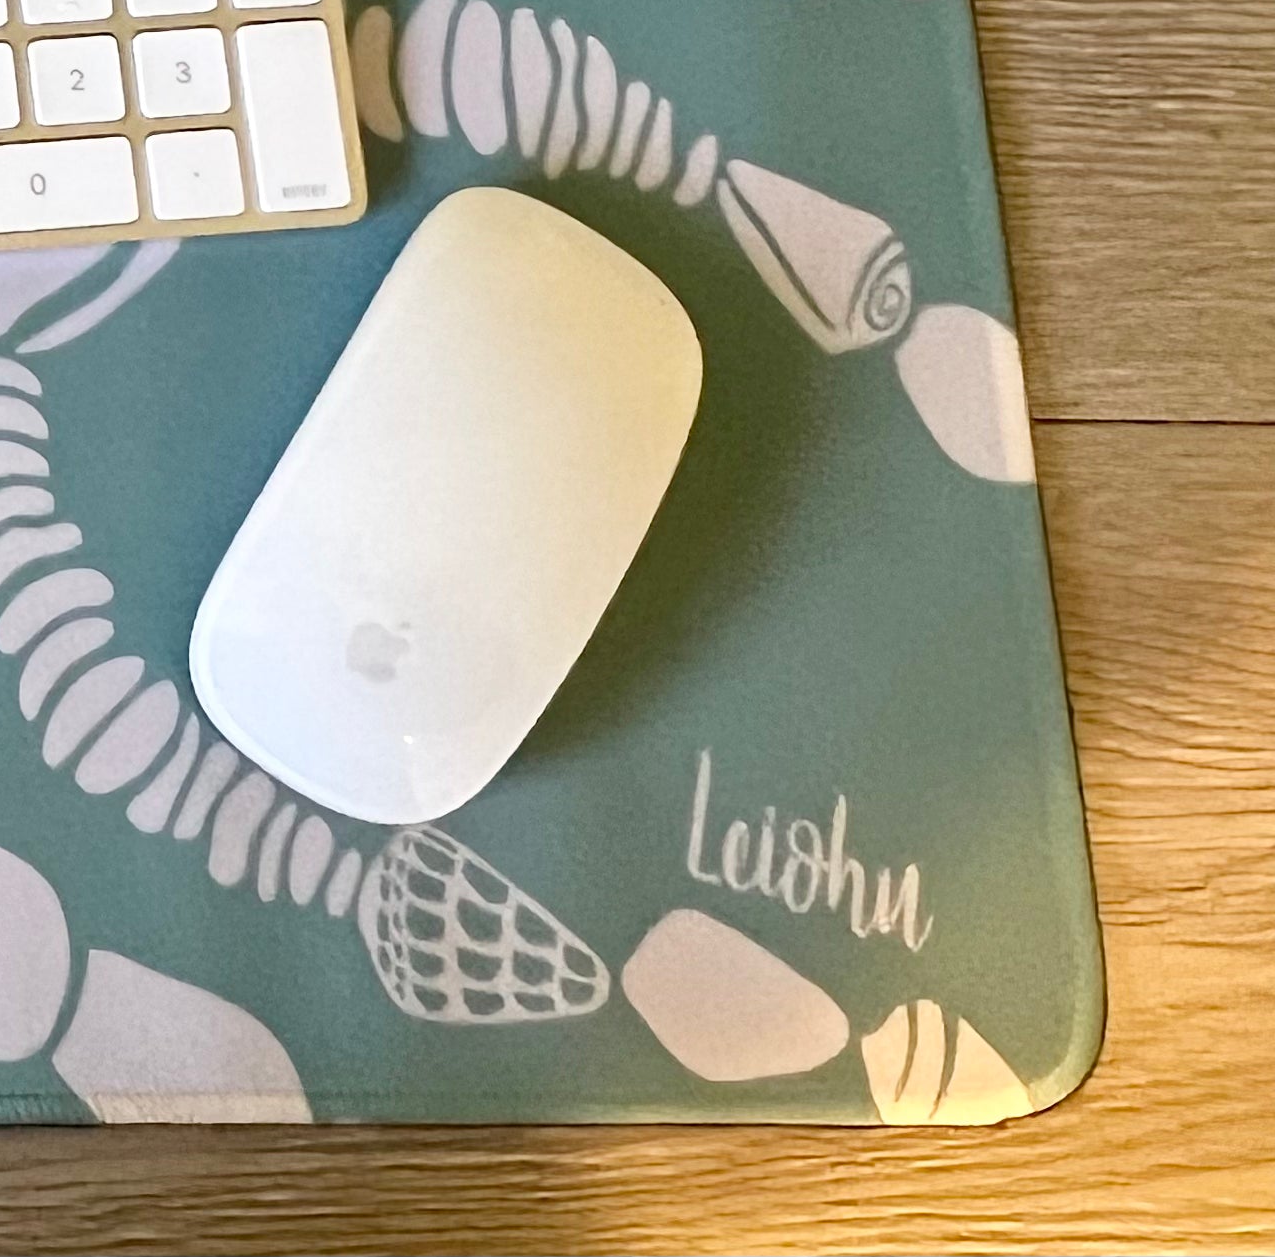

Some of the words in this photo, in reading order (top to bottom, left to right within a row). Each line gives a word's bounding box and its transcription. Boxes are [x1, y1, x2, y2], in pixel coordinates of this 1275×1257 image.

[69, 68, 86, 91] 2
[175, 60, 193, 84] 3
[29, 172, 47, 196] 0
